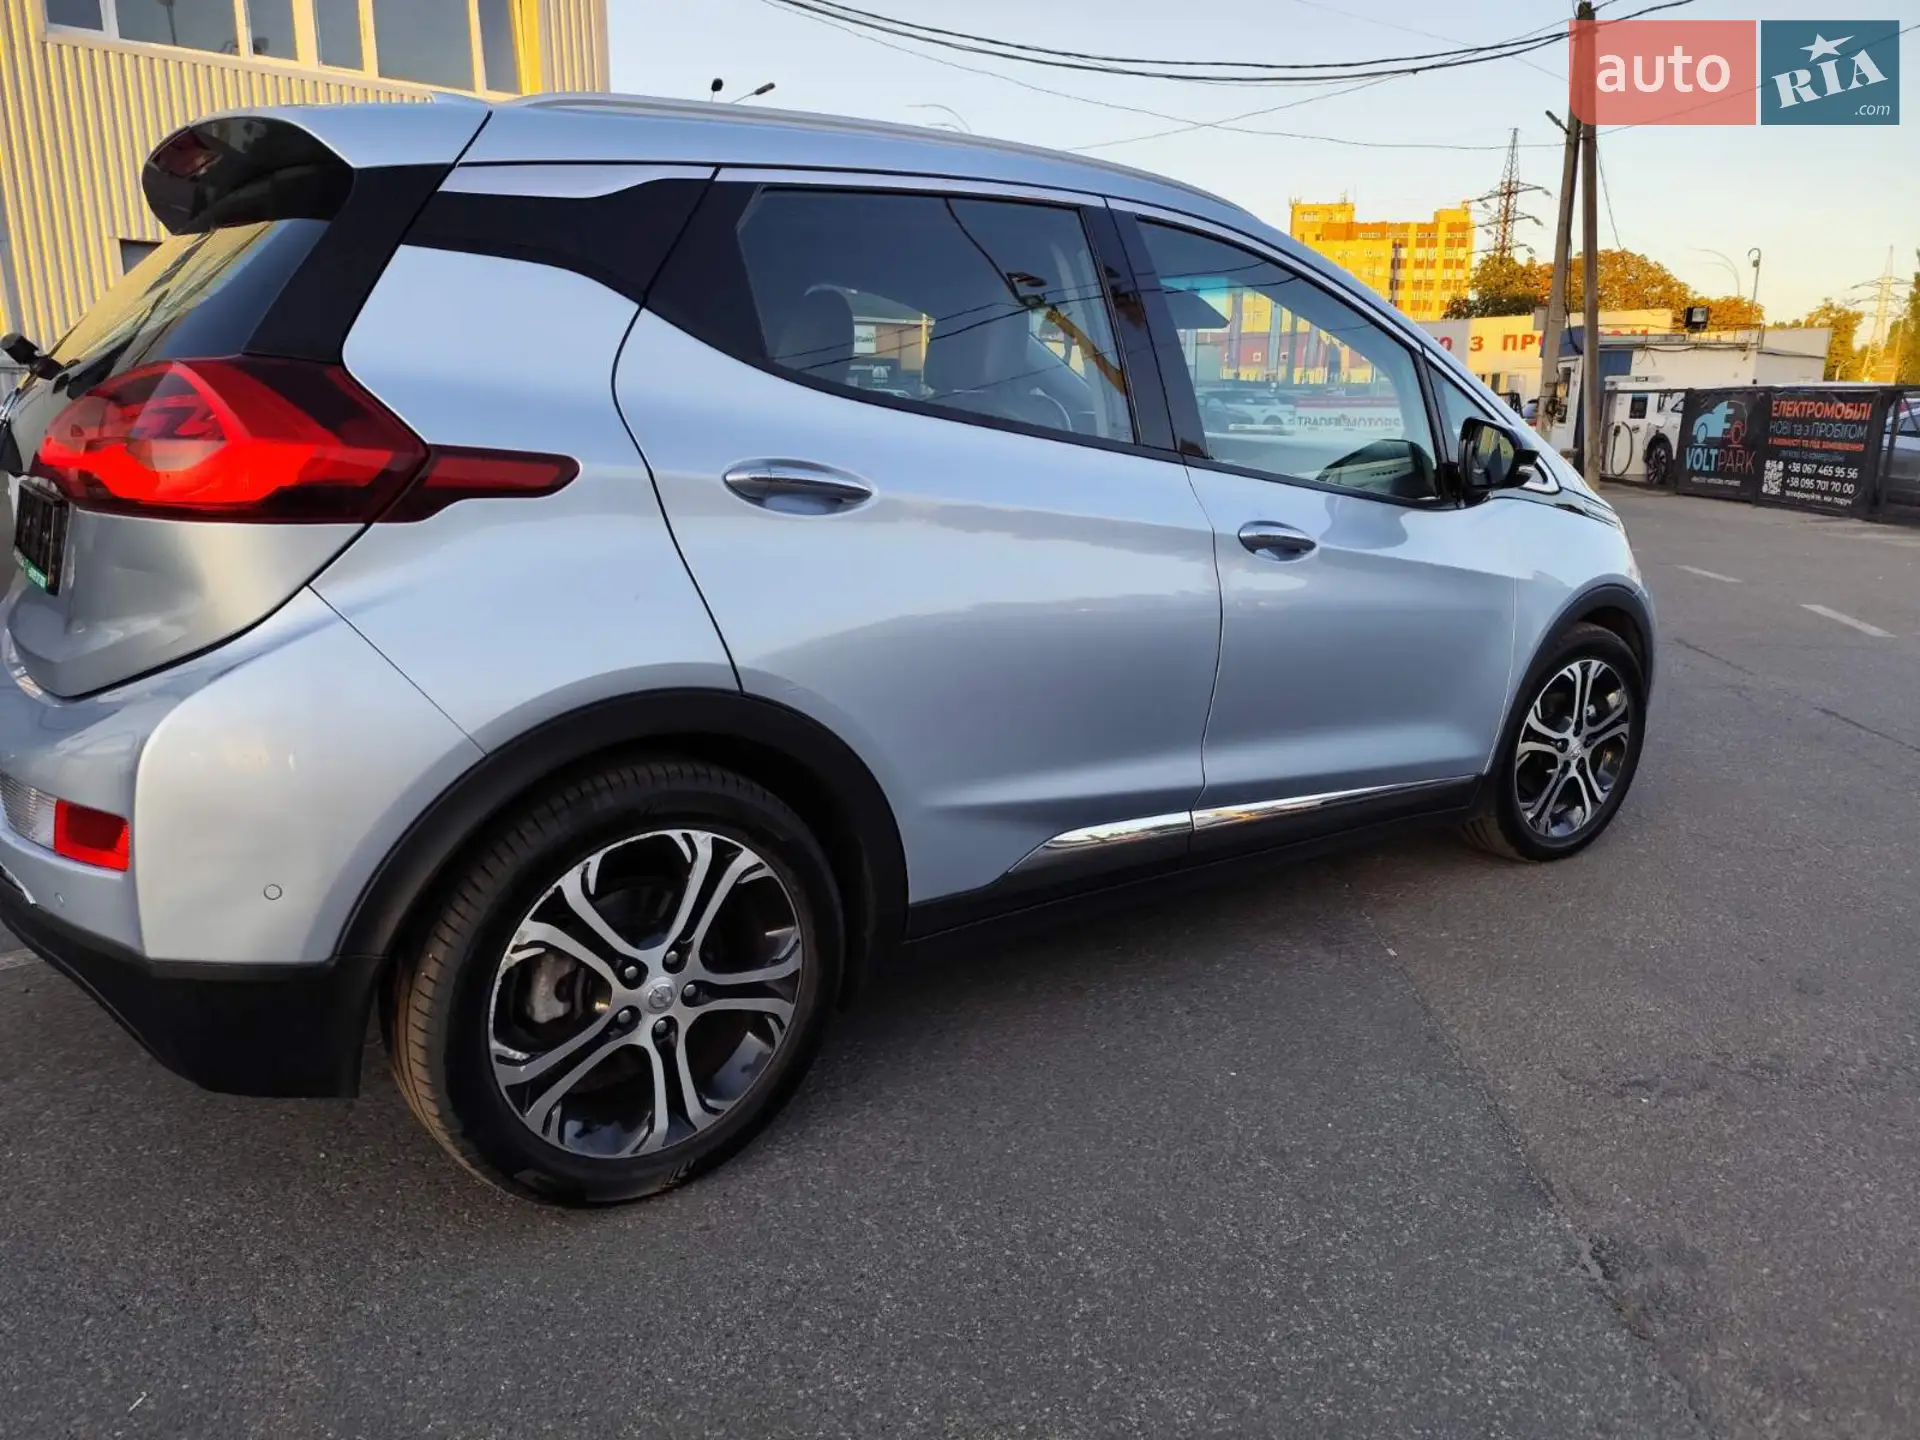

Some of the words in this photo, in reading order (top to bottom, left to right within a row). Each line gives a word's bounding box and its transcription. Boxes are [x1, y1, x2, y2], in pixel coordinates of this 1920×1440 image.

[1771, 400, 1873, 421] ЕЛЕКТРОМОБІЛІ
[1769, 420, 1791, 436] НОВІ
[1810, 422, 1868, 440] ПРОБІГОМ
[1787, 462, 1801, 473] +38
[1802, 464, 1817, 475] 067
[1818, 465, 1834, 477] 465
[1834, 466, 1846, 478] 95
[1846, 468, 1859, 480] 56
[1786, 477, 1799, 488] +38
[1800, 478, 1815, 490] 095
[1816, 479, 1830, 491] 701
[1830, 481, 1841, 493] 70
[1842, 483, 1855, 495] 00
